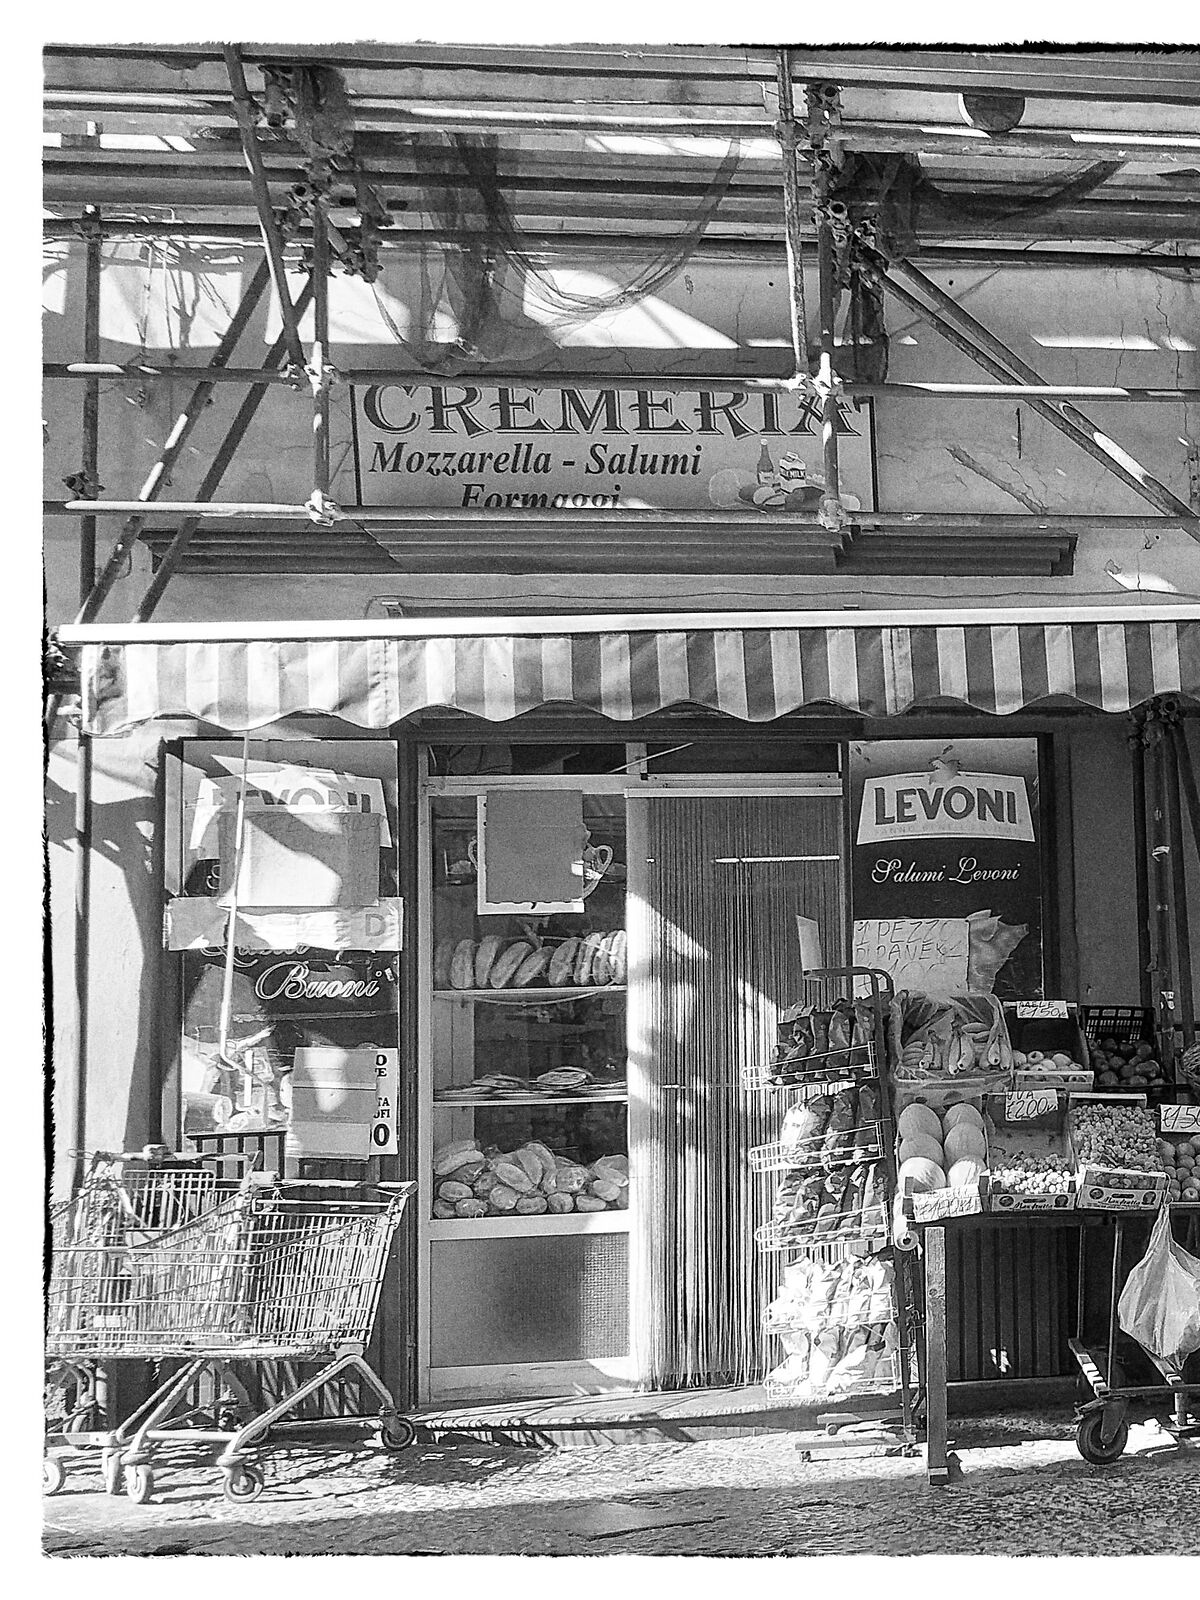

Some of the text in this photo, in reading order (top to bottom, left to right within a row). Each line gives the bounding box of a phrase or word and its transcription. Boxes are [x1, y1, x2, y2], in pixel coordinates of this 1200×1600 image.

[363, 385, 862, 440] CREMERIA
[368, 441, 552, 477] Mozzarella
[584, 442, 703, 476] Salumi
[874, 785, 1018, 826] LEVONI
[871, 856, 1021, 884] Salumi Levoni
[855, 920, 871, 947] 1
[255, 959, 382, 1000] Buoni
